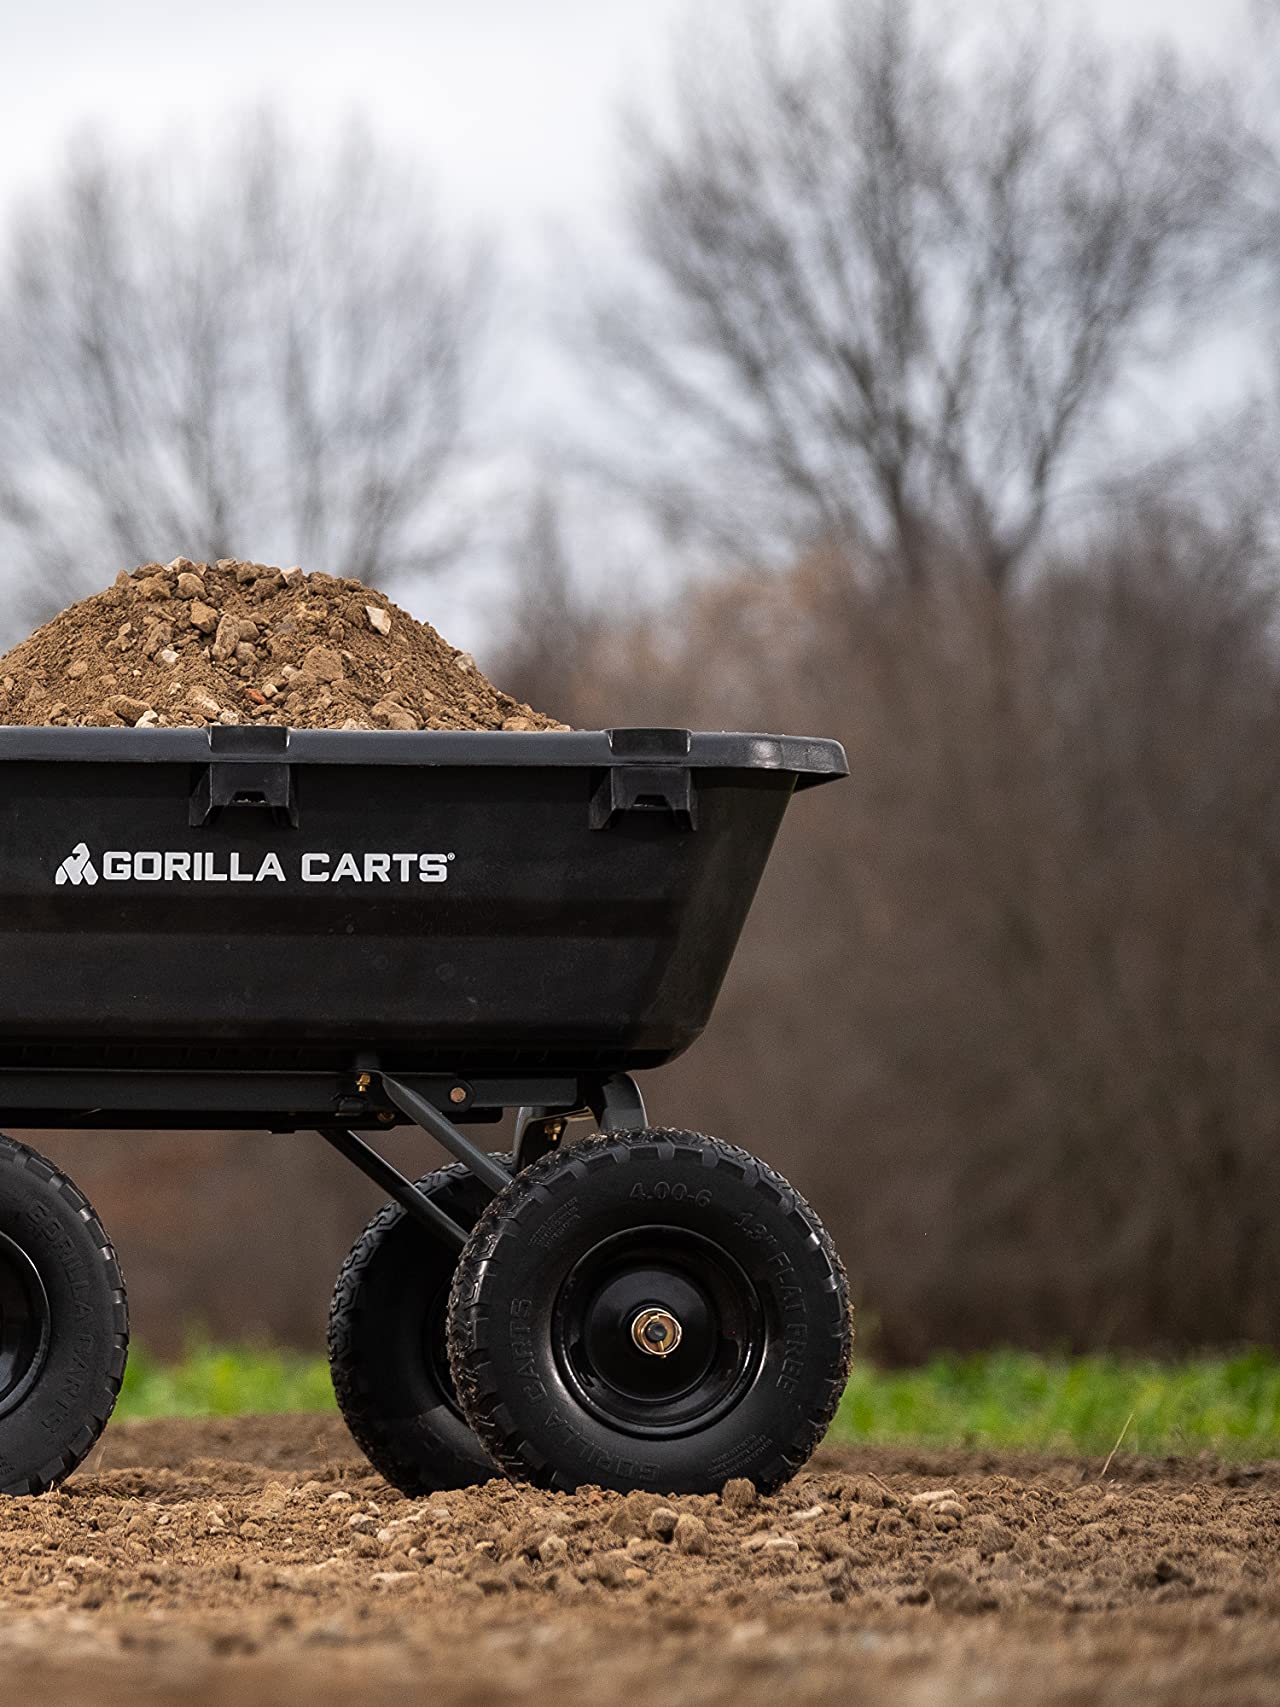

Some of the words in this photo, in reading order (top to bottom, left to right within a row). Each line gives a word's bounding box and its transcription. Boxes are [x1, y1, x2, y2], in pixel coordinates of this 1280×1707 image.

[102, 850, 287, 883] GORILLA
[628, 1181, 713, 1209] 4.00-6
[767, 1250, 807, 1314] FLAT
[510, 1297, 548, 1406] CARTS
[774, 1325, 808, 1396] FREE
